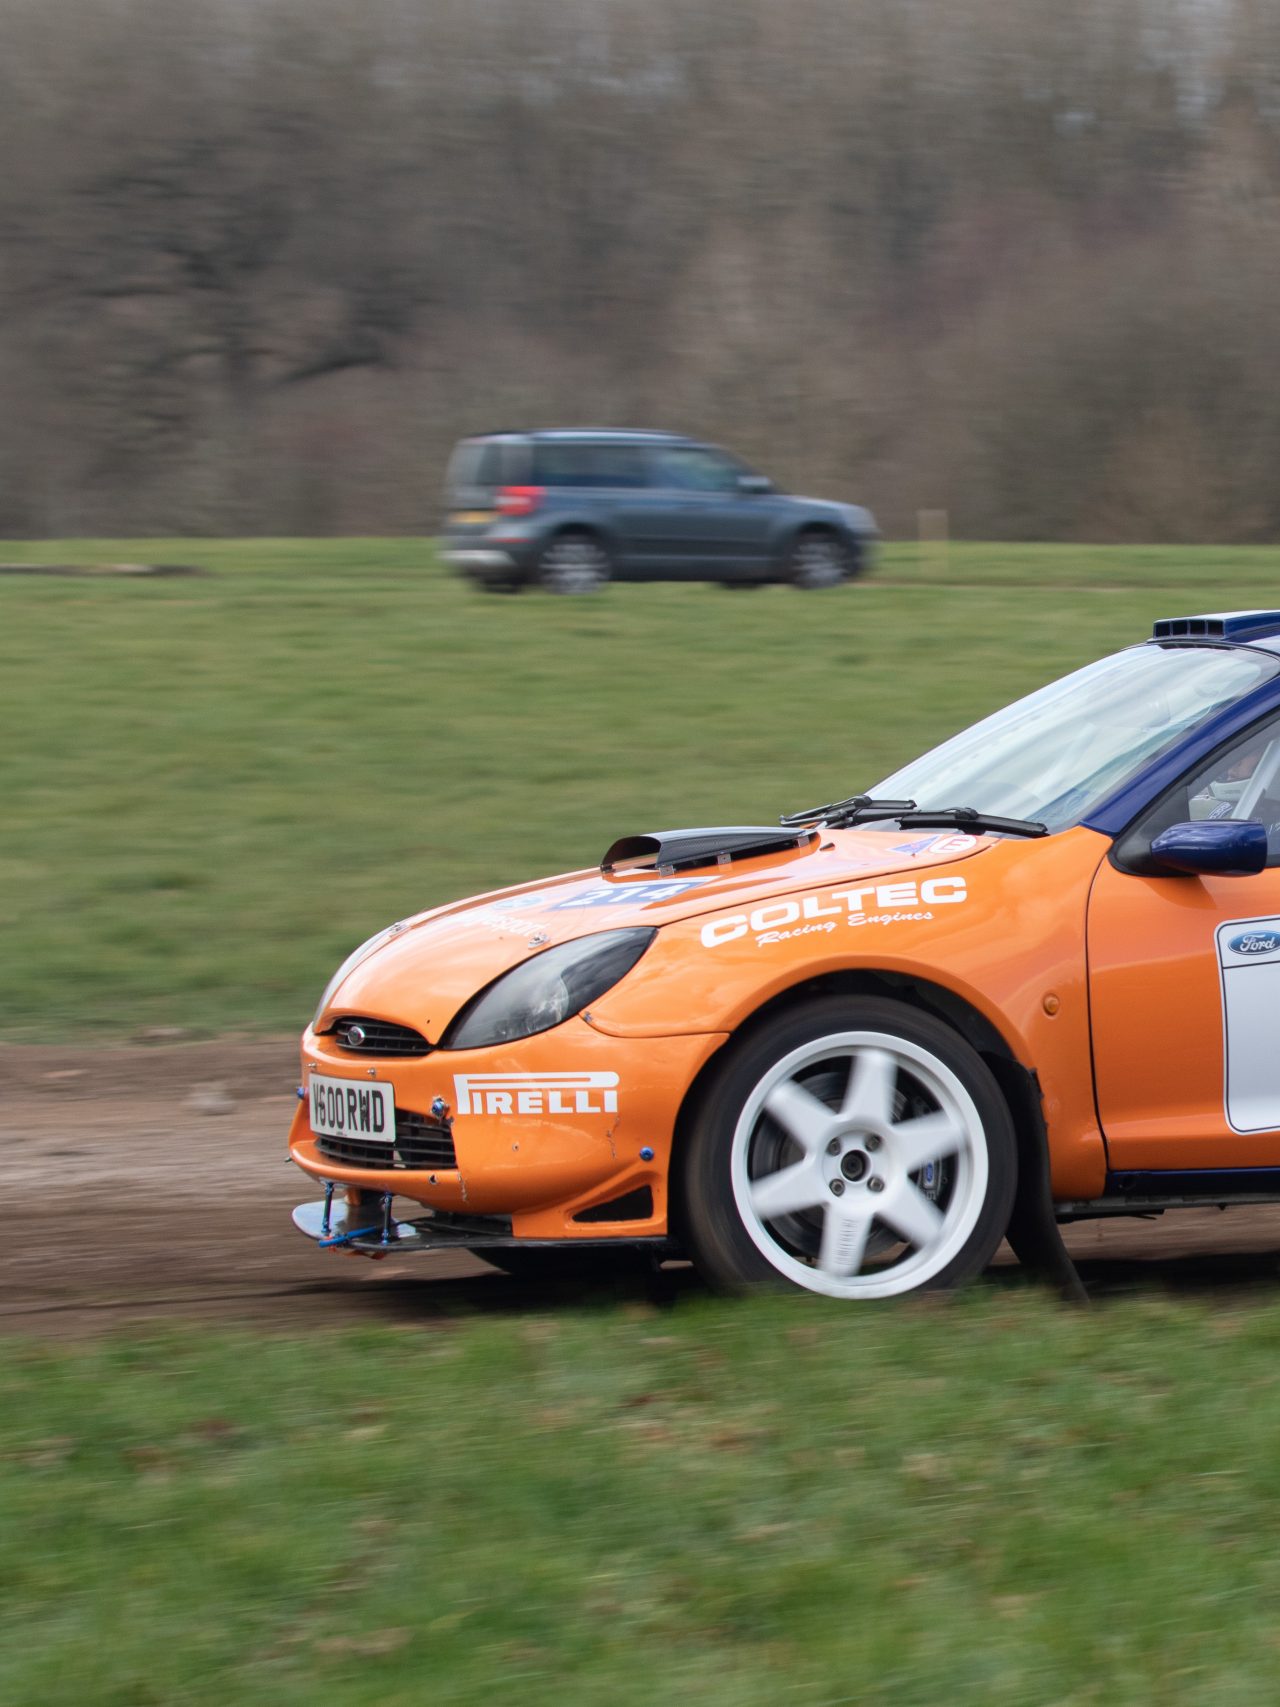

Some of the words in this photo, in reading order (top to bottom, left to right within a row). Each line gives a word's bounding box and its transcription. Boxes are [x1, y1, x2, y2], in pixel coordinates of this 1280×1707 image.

[700, 876, 967, 948] COLTEC
[755, 920, 837, 948] Racing
[847, 910, 935, 928] Engines
[1239, 934, 1276, 951] Ford
[453, 1071, 620, 1115] PIRELLI
